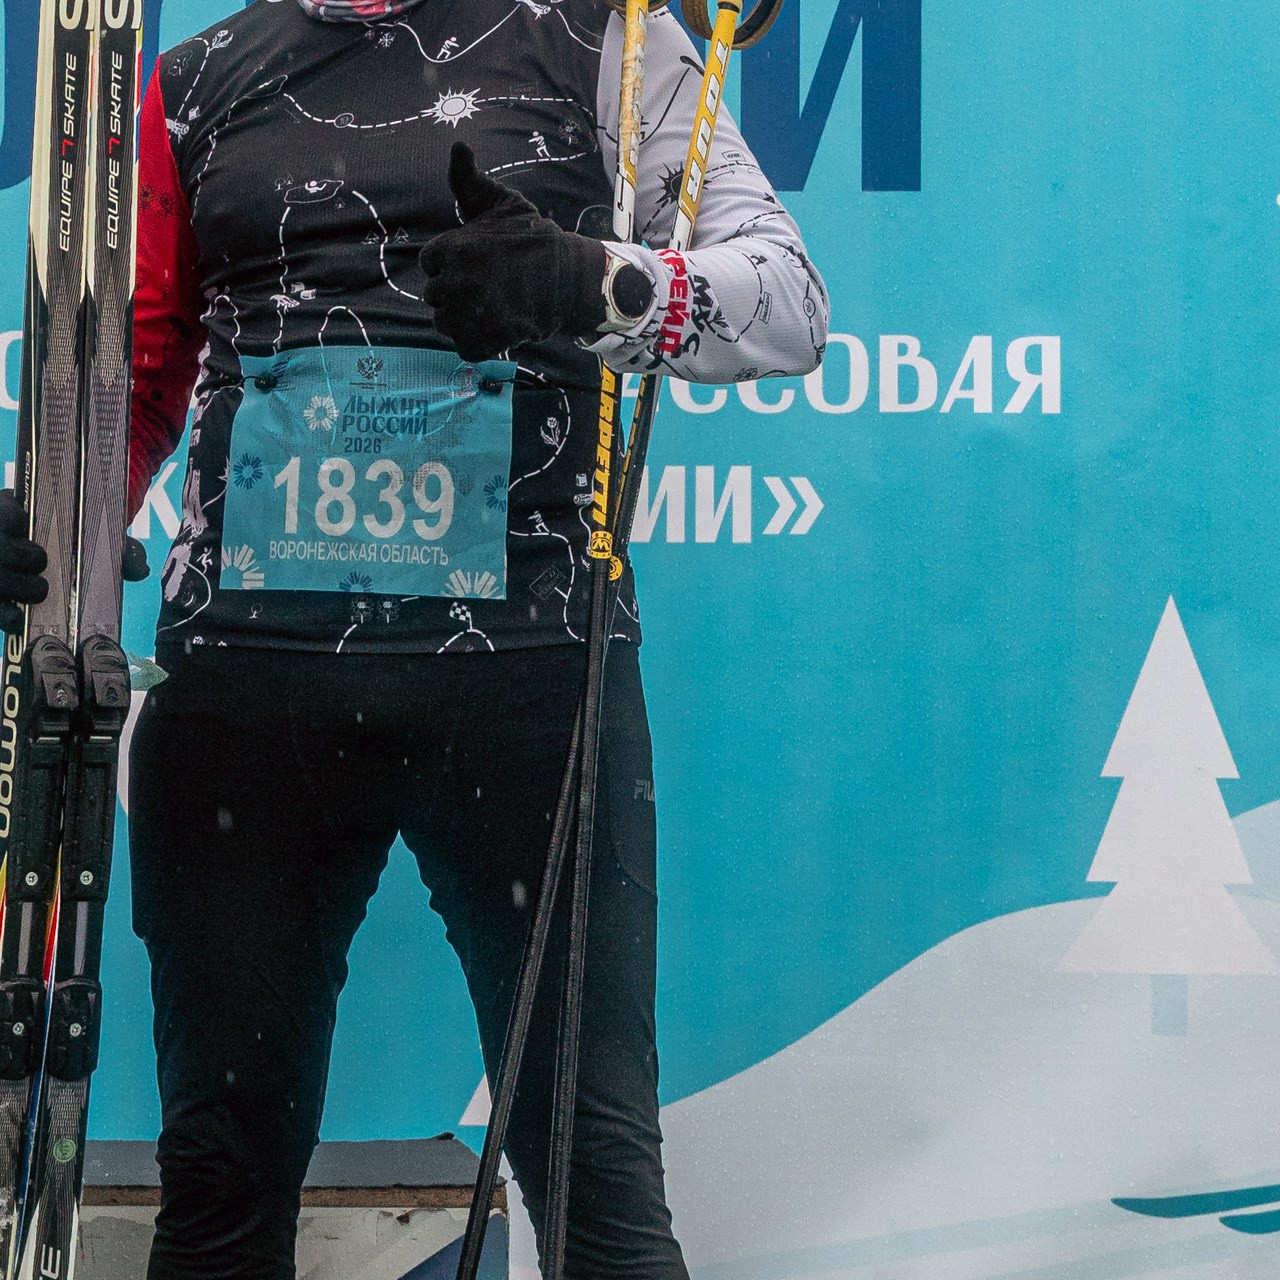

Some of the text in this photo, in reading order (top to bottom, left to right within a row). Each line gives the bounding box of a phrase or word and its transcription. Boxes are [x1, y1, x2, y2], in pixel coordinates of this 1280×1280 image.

[63, 51, 78, 138] SKATE
[109, 50, 123, 137] SKATE
[683, 37, 730, 206] TOUR
[58, 156, 76, 253] EQUIPE
[106, 157, 122, 251] EQUIPE
[342, 414, 429, 435] РОССИИ
[343, 396, 429, 417] ЛЫЖНЯ
[344, 437, 382, 454] 2026
[592, 361, 618, 528] ARPETTI
[273, 455, 455, 541] 1839
[269, 540, 449, 566] ВОРОНЕЖСКАЯ ОБЛАСТЬ
